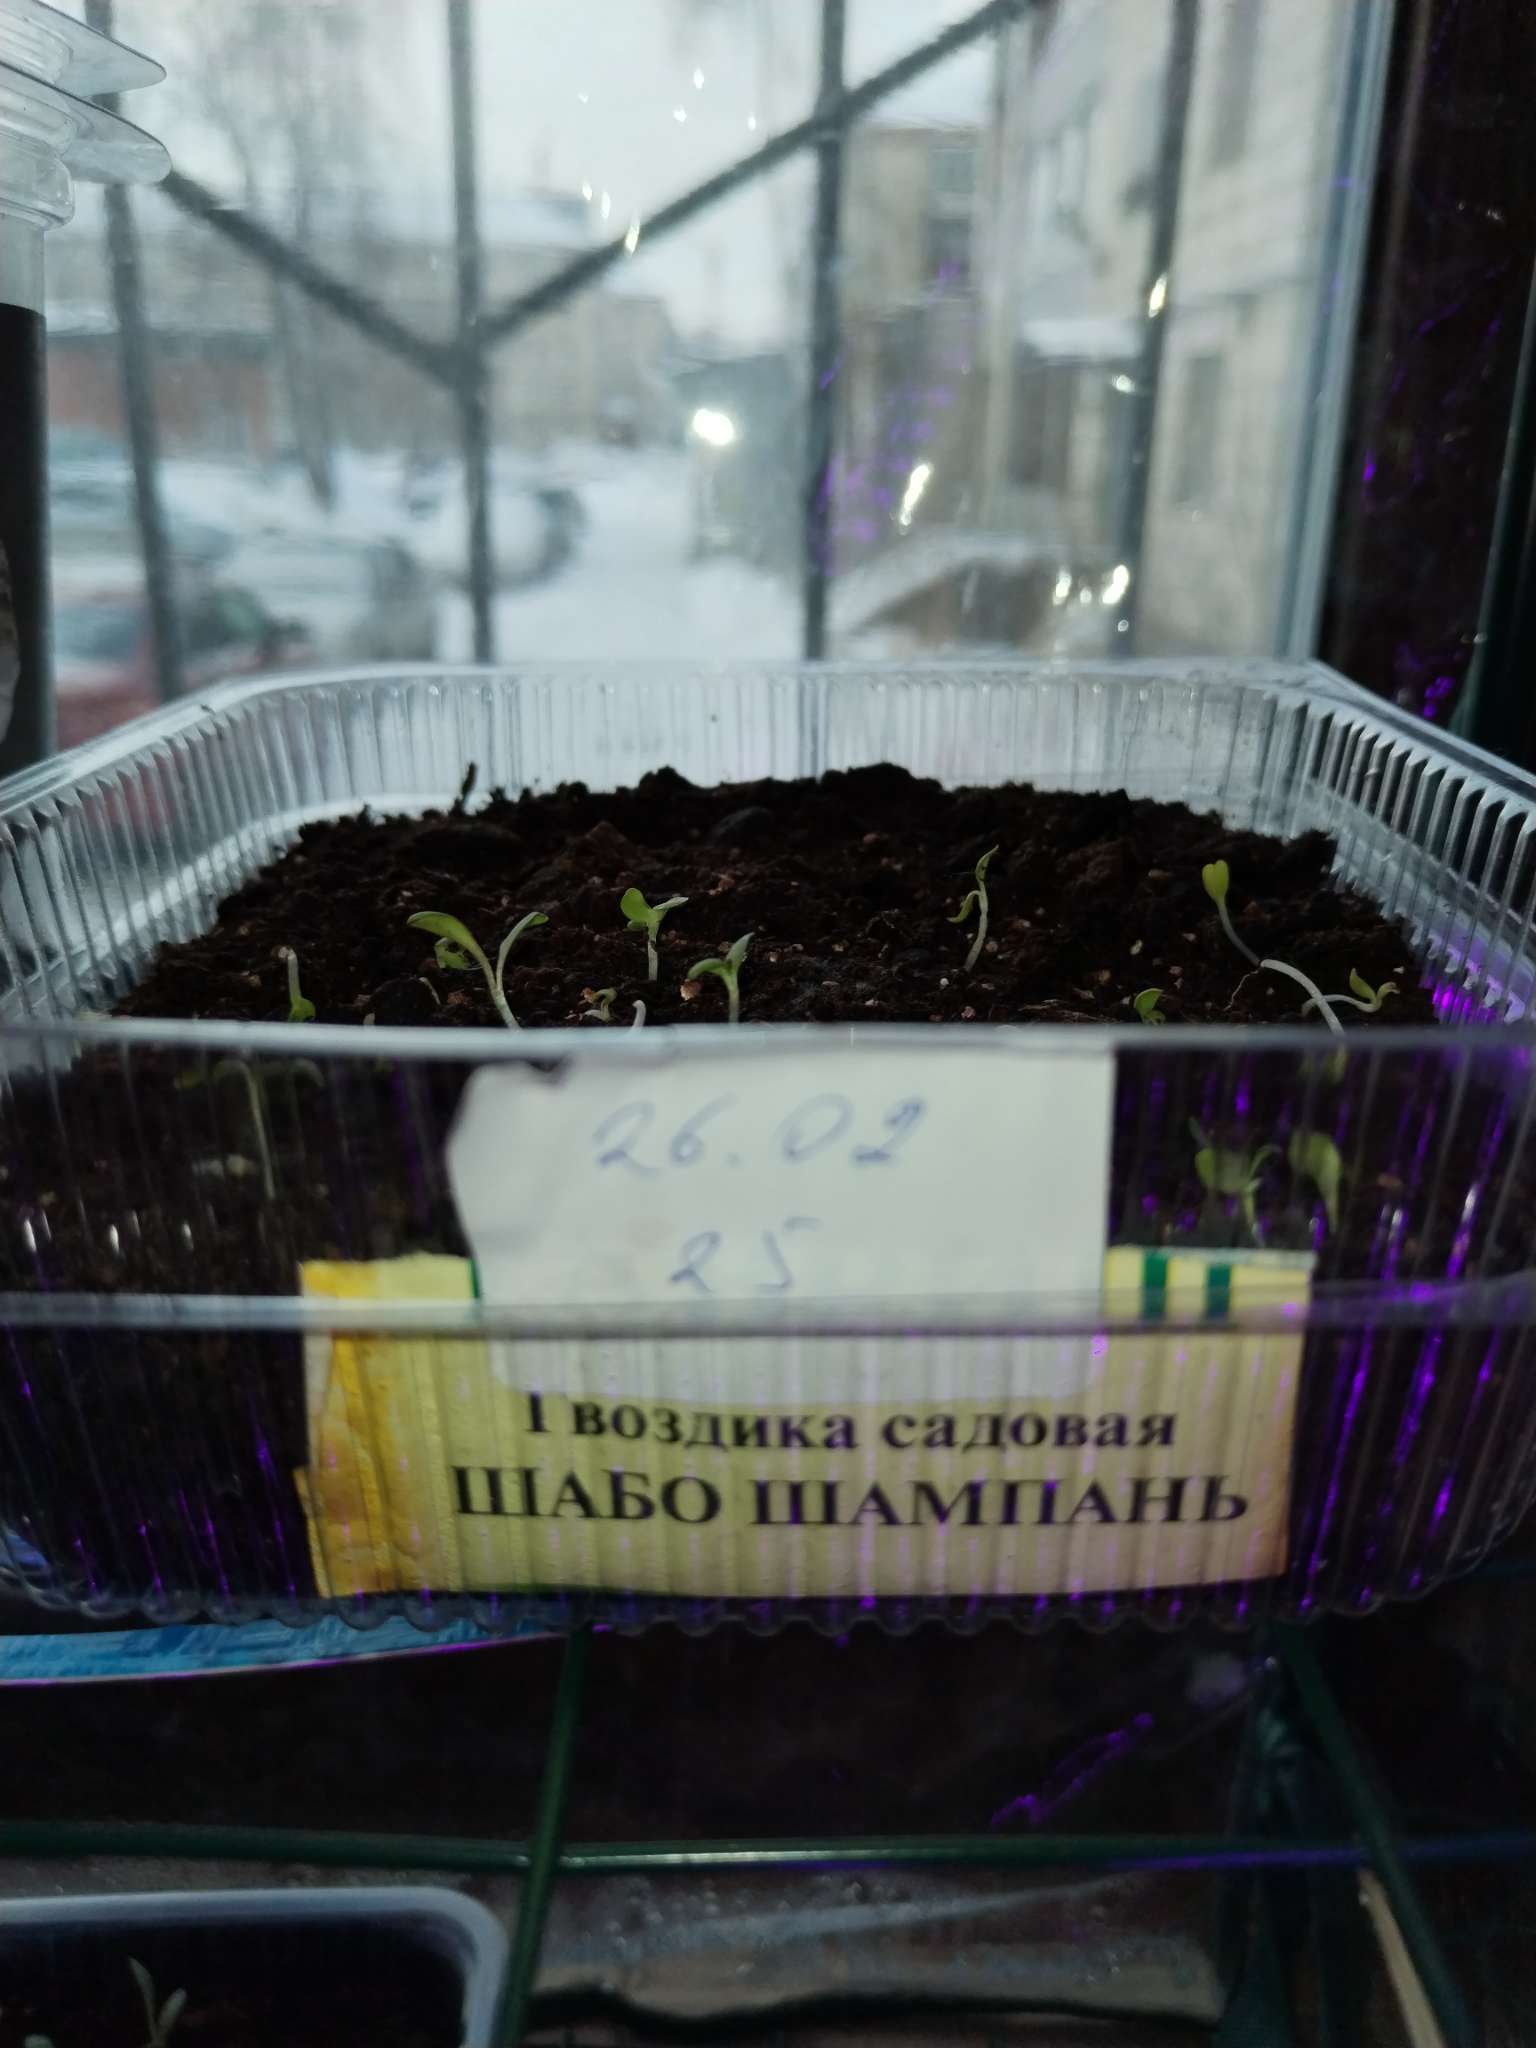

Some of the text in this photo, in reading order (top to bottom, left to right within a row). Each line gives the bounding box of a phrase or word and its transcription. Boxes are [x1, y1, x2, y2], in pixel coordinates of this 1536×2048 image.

[594, 1094, 926, 1176] 26.02
[881, 1411, 1177, 1454] садовая
[450, 1465, 1248, 1525] ШАБО ШАМПАНЬ
